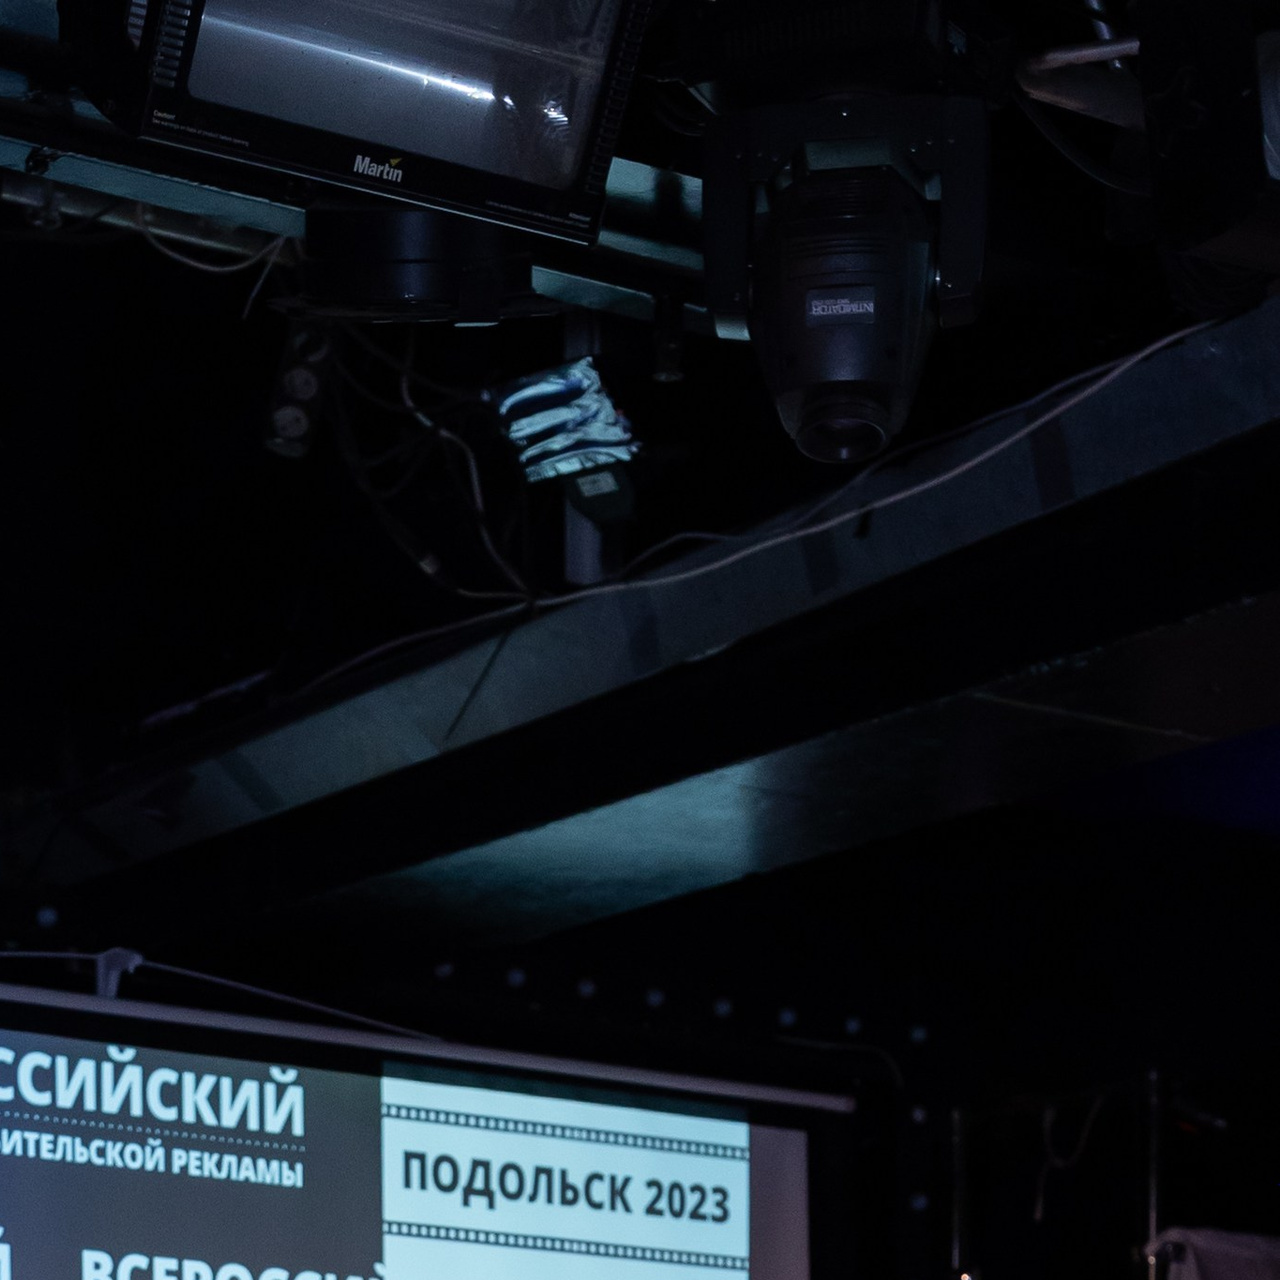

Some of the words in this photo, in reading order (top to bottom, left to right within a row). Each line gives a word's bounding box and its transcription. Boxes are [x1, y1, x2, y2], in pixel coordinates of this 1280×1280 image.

[353, 154, 403, 183] Martin
[171, 1149, 303, 1188] РЕКЛАМЫ
[403, 1150, 632, 1213] ПОДОЛЬСК
[645, 1179, 730, 1224] 2023
